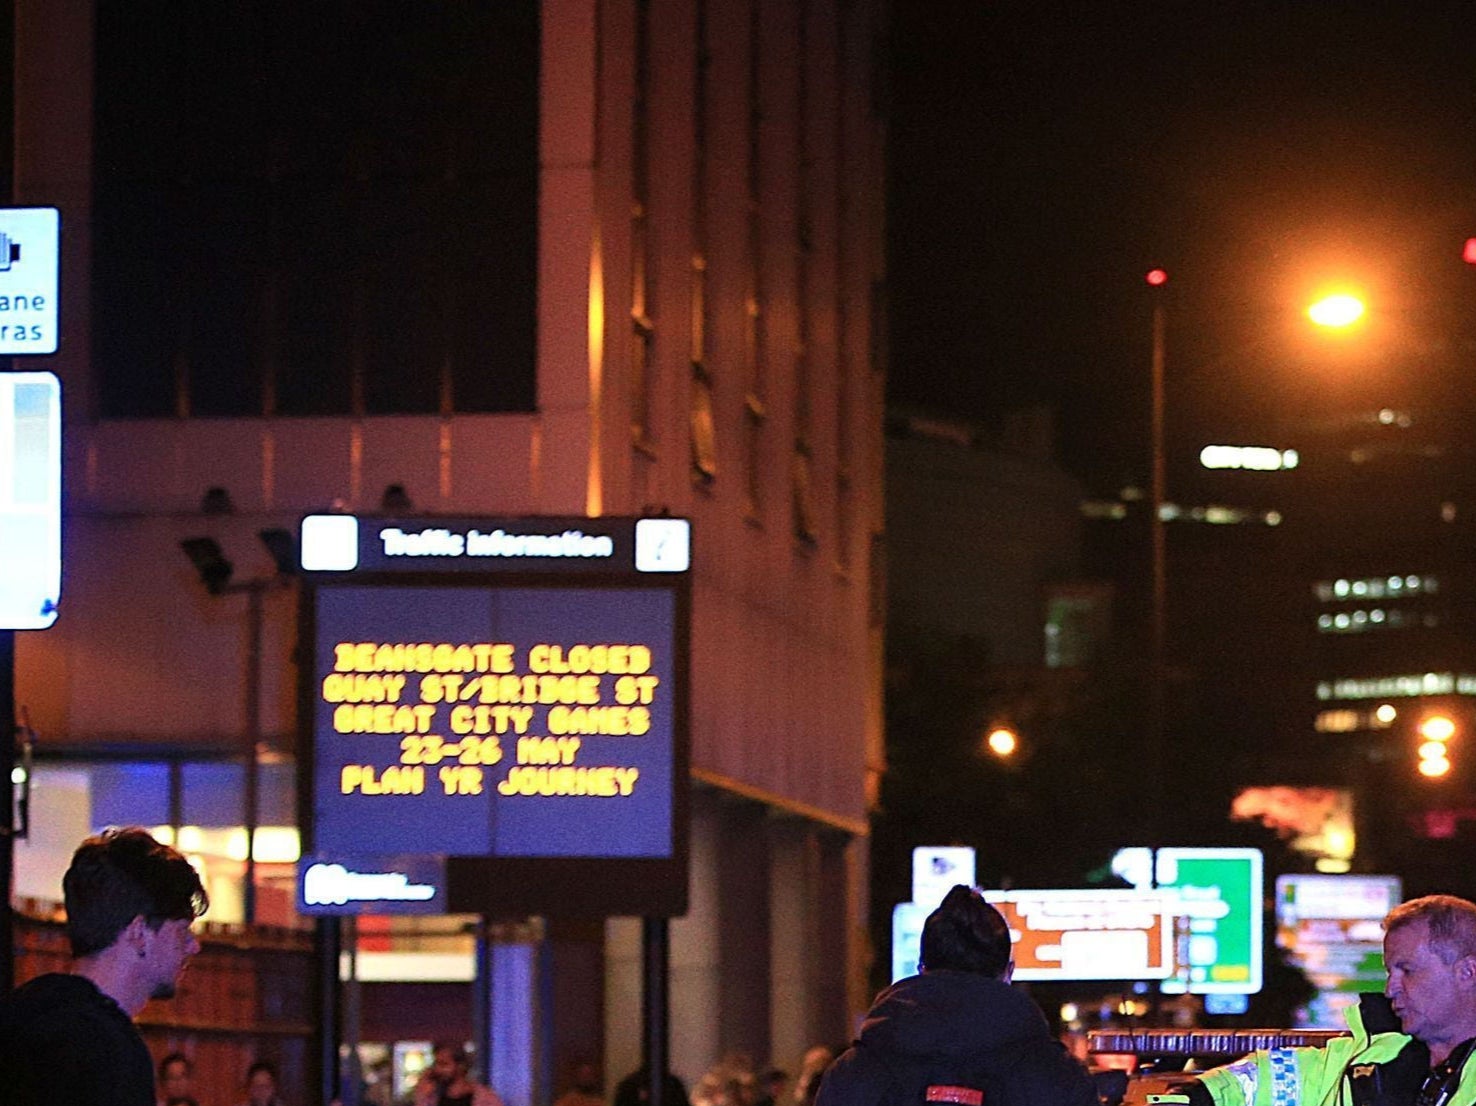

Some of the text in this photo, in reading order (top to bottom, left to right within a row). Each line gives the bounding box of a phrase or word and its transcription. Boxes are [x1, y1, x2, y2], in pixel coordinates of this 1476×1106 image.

[380, 529, 464, 556] Traffic
[333, 643, 652, 674] DEANSGATE CLOSED
[322, 673, 660, 705] QUAY ST/BRIDGE ST
[333, 704, 651, 736] GREAT CITY GAMES
[516, 736, 581, 766] MAY
[341, 765, 640, 796] PLAN YR JOURNEY
